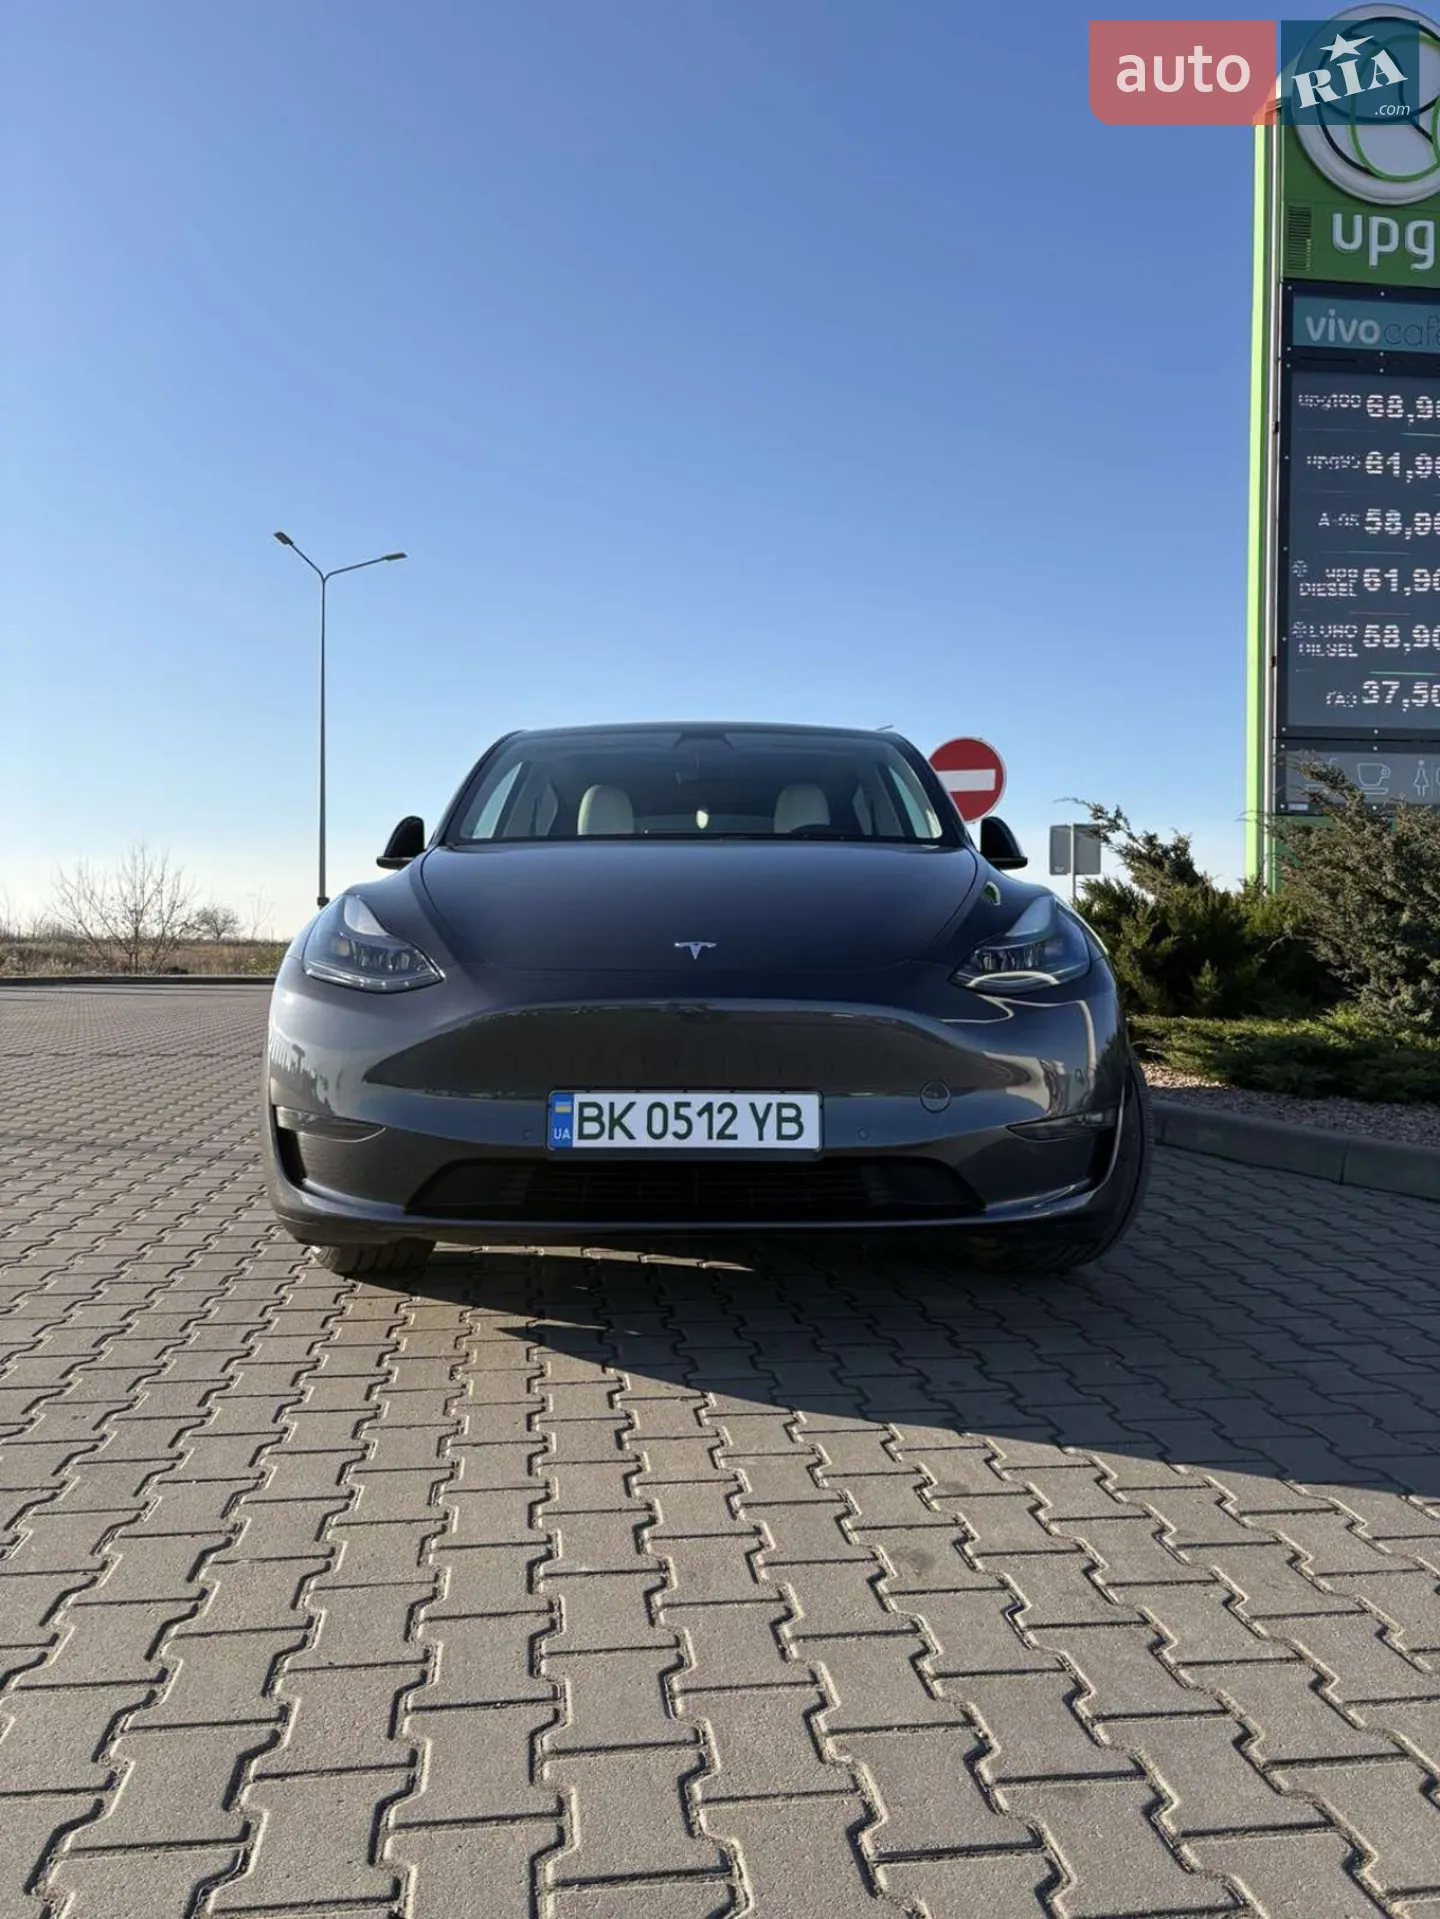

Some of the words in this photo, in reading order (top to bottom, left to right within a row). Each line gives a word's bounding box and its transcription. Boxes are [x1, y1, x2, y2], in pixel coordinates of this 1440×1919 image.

[1331, 212, 1436, 270] upg
[1383, 314, 1440, 347] caf
[1366, 394, 1440, 426] 68,9
[1299, 582, 1358, 597] DIESEL
[553, 1127, 571, 1140] UA
[577, 1101, 637, 1141] BK
[646, 1101, 739, 1141] 0512
[749, 1101, 805, 1142] YB
